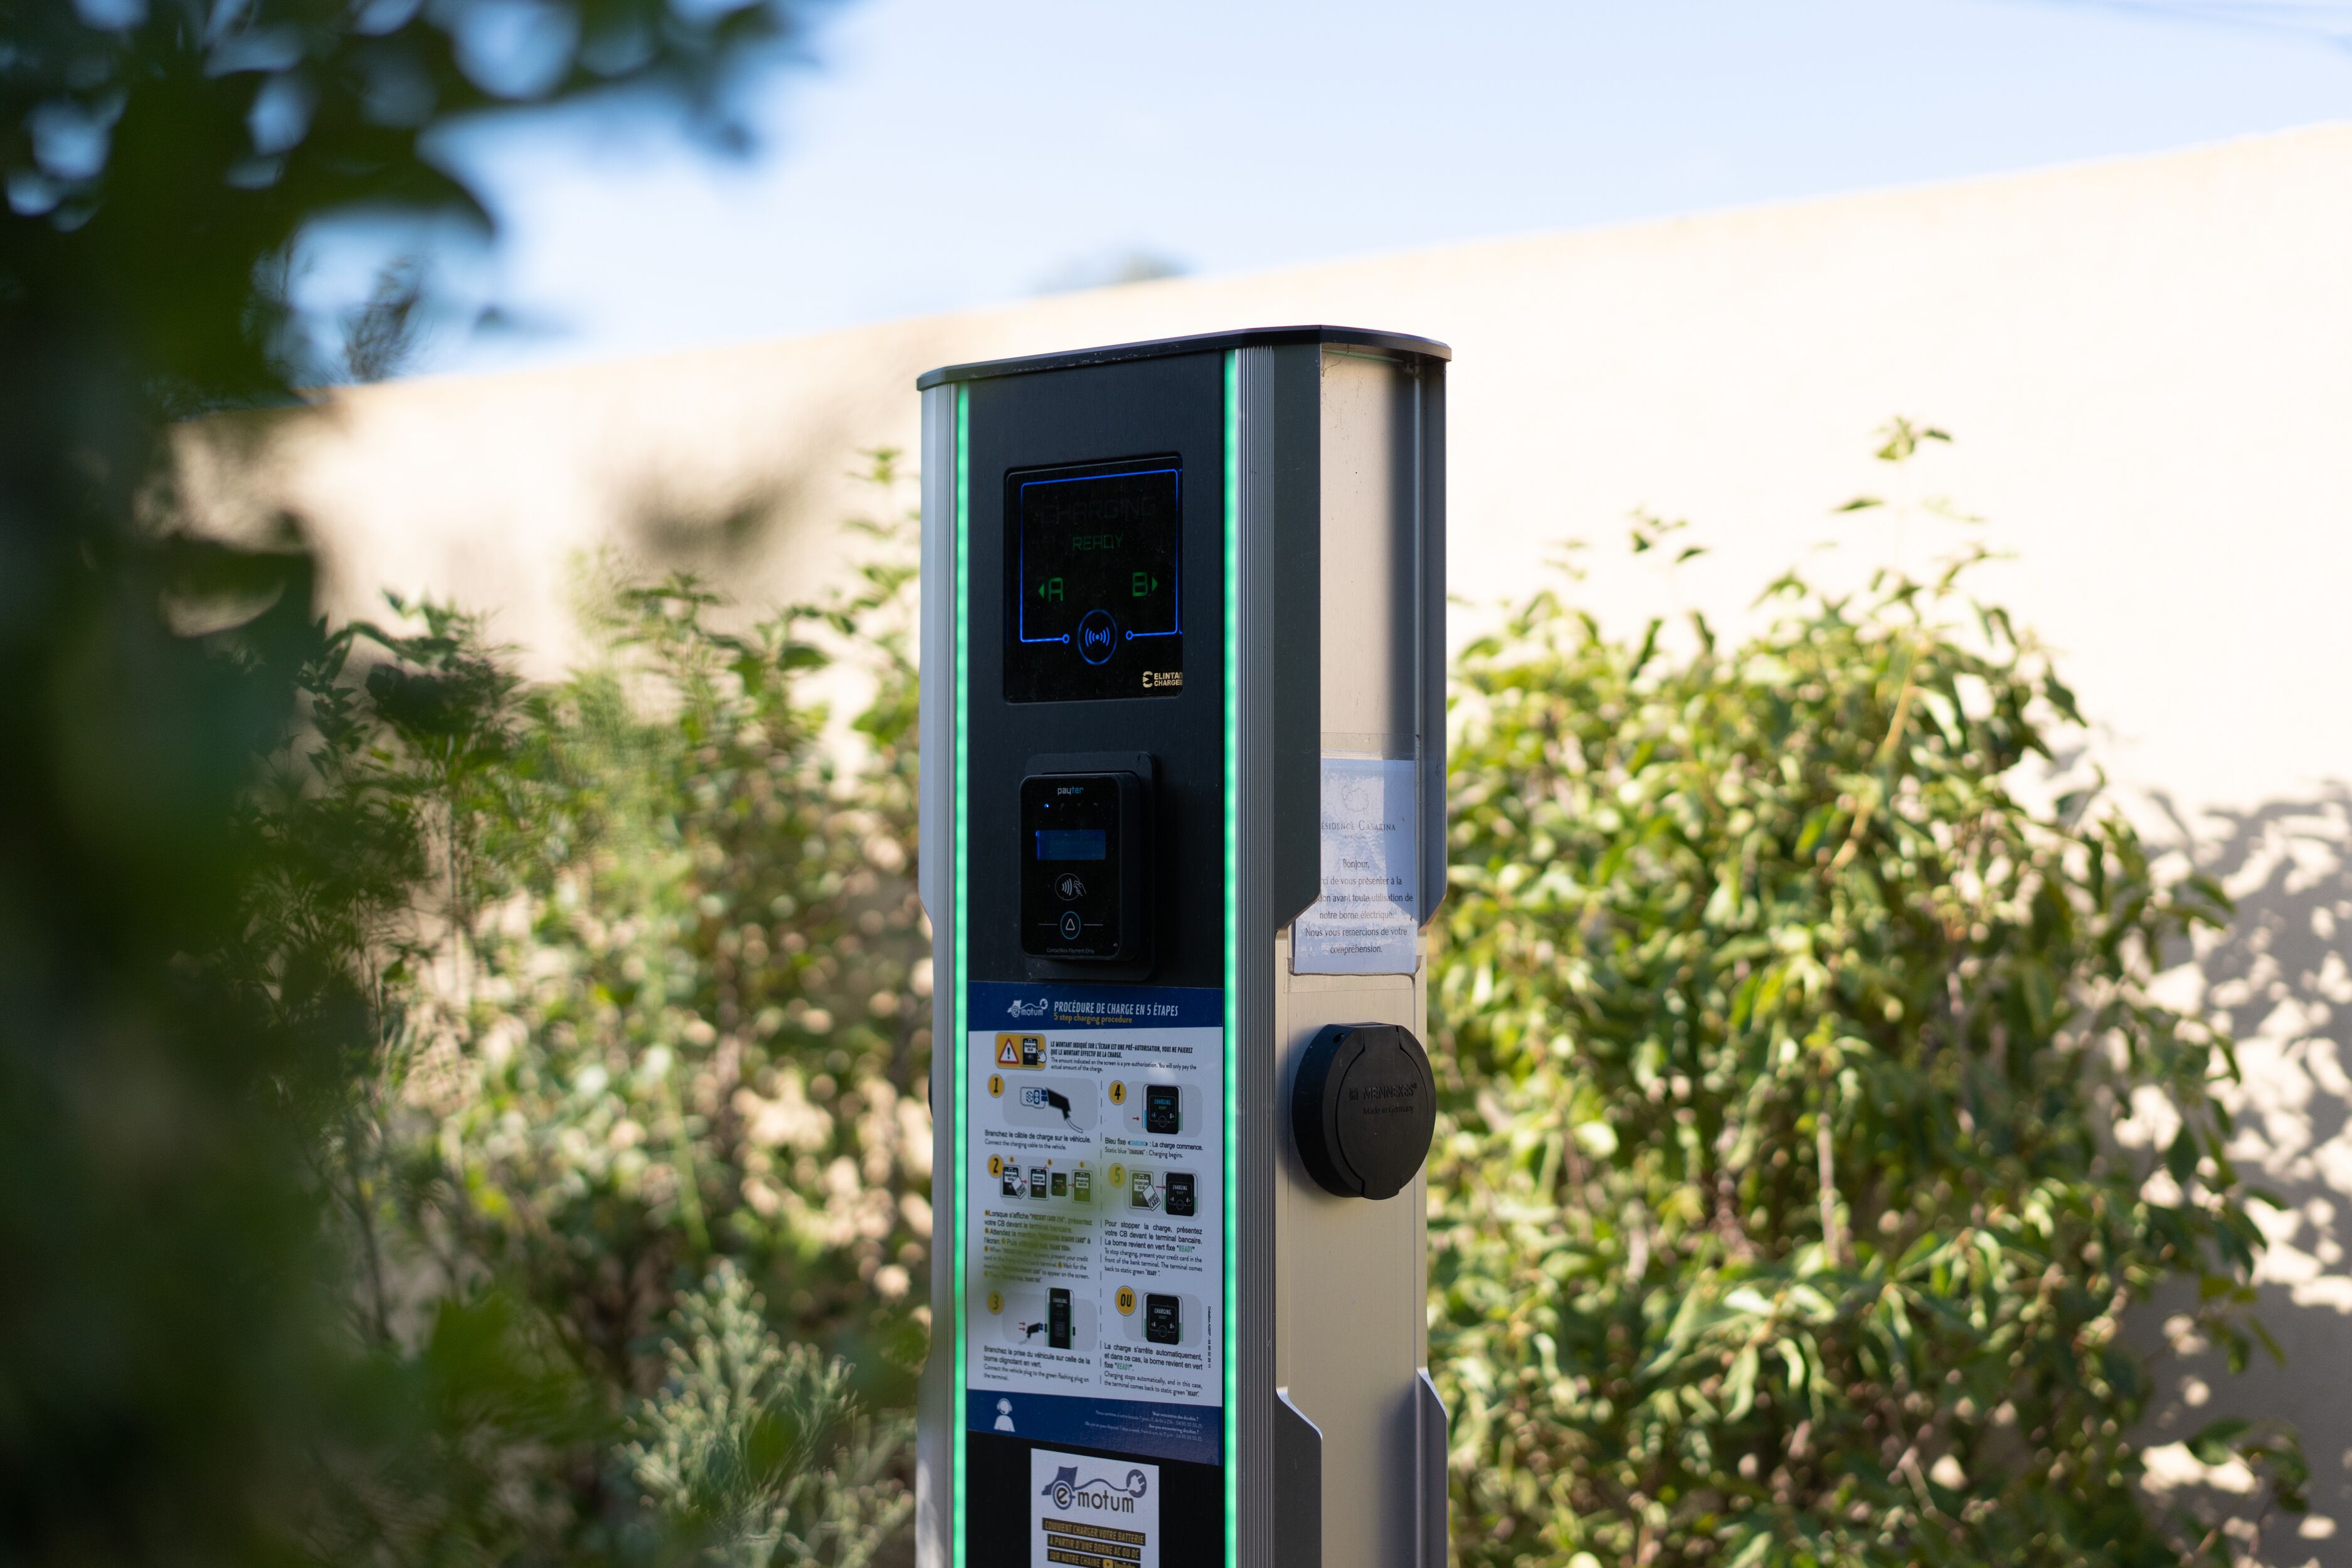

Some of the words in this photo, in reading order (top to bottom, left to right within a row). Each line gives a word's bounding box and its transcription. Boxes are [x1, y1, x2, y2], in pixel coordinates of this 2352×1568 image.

[1073, 532, 1123, 551] READY
[1049, 578, 1063, 601] A
[1133, 572, 1148, 596] B
[1057, 785, 1084, 796] payter
[1321, 822, 1355, 830] ÉSIDENCE
[1343, 859, 1370, 869] Bonjour,
[1331, 876, 1338, 885] de
[1359, 877, 1389, 887] présenter
[1391, 877, 1394, 885] à
[1396, 876, 1402, 885] la
[1353, 894, 1370, 902] toute
[1372, 894, 1403, 902] utilisation
[1404, 893, 1413, 902] de
[1320, 911, 1337, 919] notre
[1339, 911, 1359, 919] borne
[1360, 911, 1394, 921] électrique.
[1305, 928, 1323, 936] Nous
[1342, 928, 1379, 936] remercions
[1381, 927, 1389, 936] de
[1391, 928, 1407, 936] votre
[1330, 945, 1382, 955] compréhension.
[1054, 1000, 1094, 1013] PROCÉDURE
[1096, 1003, 1105, 1014] DE
[1107, 1004, 1134, 1014] CHARGE
[1135, 1004, 1145, 1015] EN
[1147, 1004, 1151, 1015] 5
[1153, 1003, 1178, 1016] ÉTAPES
[1059, 1014, 1073, 1024] step
[1074, 1014, 1100, 1025] charging
[1101, 1015, 1133, 1025] procedure
[993, 1078, 999, 1093] 1
[1114, 1084, 1121, 1100] 4
[1363, 1106, 1380, 1115] Made
[1389, 1105, 1414, 1115] Germany
[1036, 1133, 1054, 1142] charge
[1148, 1150, 1168, 1159] Charging
[1168, 1152, 1184, 1160] begins.
[993, 1158, 999, 1173] 2
[1115, 1167, 1121, 1183] 5
[1150, 1198, 1159, 1209] CARD
[1153, 1224, 1172, 1233] charge,
[993, 1294, 999, 1310] 3
[1120, 1293, 1132, 1307] OU
[1113, 1344, 1131, 1353] charge
[1155, 1350, 1202, 1360] automatiquement,
[1149, 1357, 1165, 1365] borne
[1057, 1487, 1134, 1513] e-motum
[1044, 1520, 1072, 1533] COMMENT
[1073, 1525, 1098, 1536] CHARGER
[1099, 1529, 1116, 1540] VOTRE
[1118, 1532, 1144, 1544] BATTERIE
